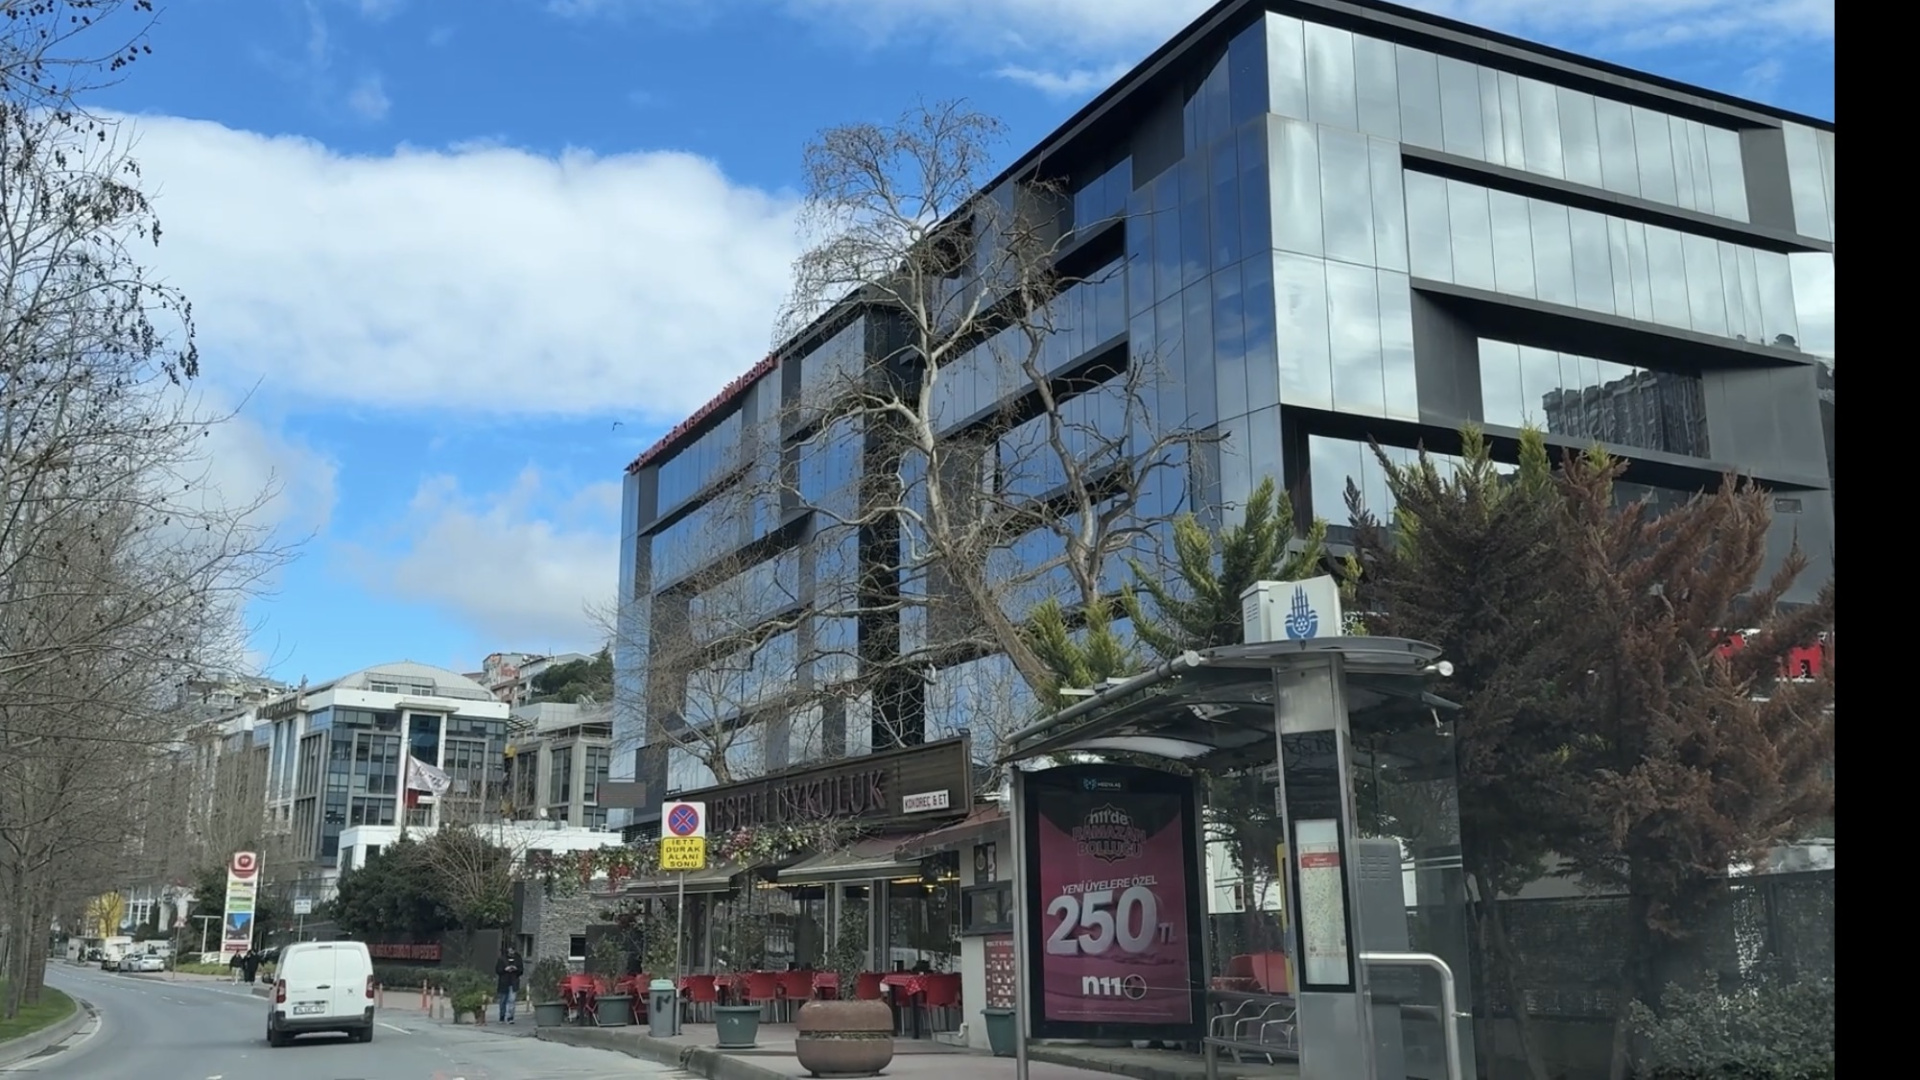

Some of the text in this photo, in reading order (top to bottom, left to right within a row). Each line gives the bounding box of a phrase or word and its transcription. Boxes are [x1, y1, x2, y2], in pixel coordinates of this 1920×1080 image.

[938, 793, 947, 805] ET
[1072, 825, 1147, 843] RAMAZAN
[1062, 874, 1158, 895] YENİ ÜYELERE ÖZEL
[1046, 886, 1177, 956] 250 TL
[1082, 976, 1121, 996] n11
